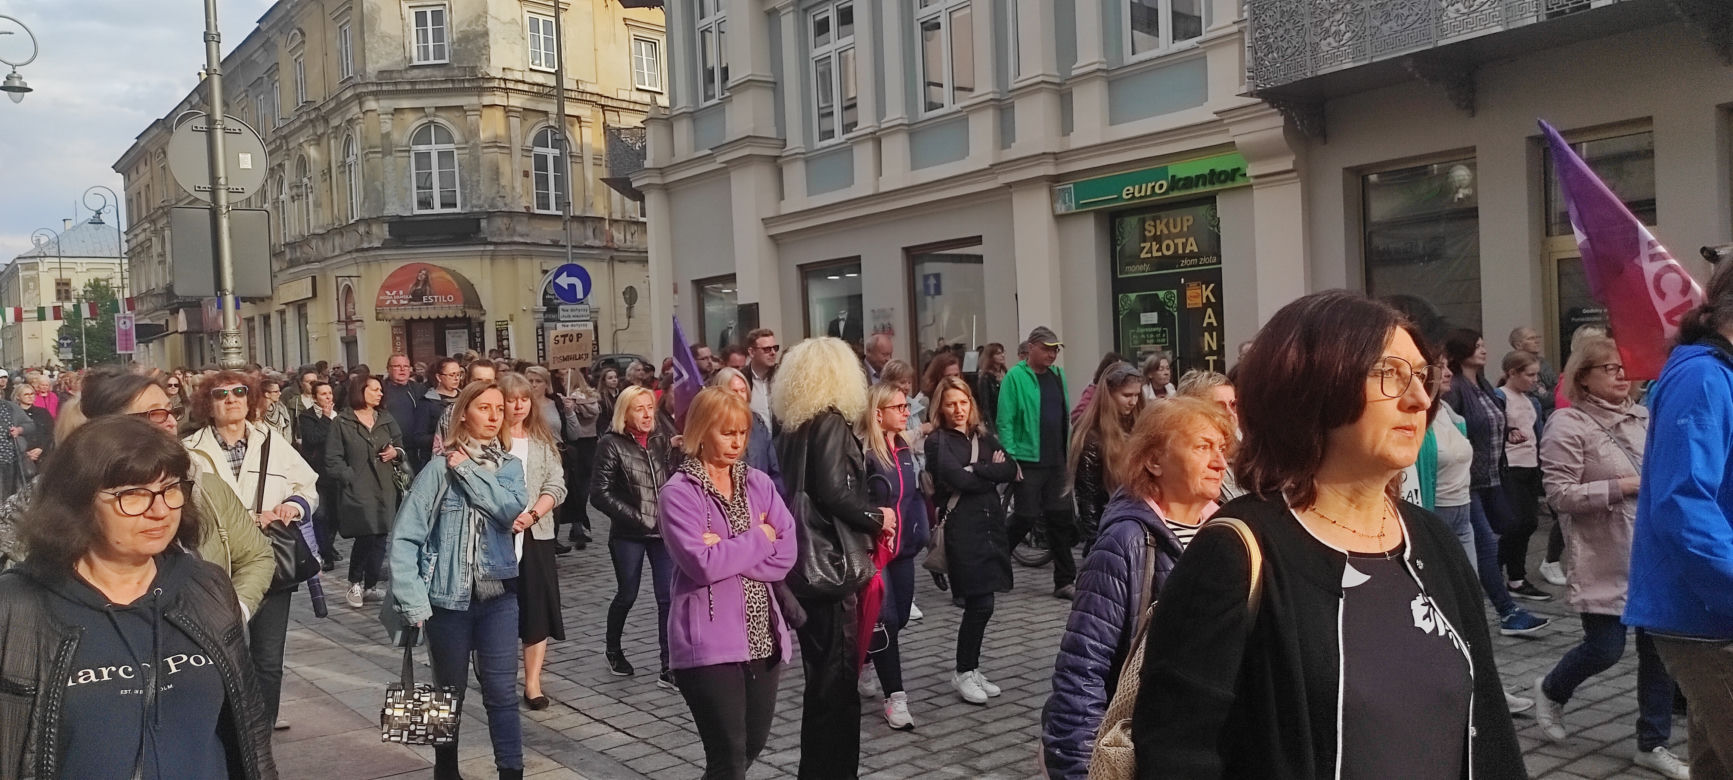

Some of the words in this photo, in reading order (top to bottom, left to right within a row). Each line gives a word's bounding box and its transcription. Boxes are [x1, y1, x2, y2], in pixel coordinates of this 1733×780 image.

[1144, 215, 1194, 237] SKUP
[1140, 237, 1198, 259] ZŁOTA
[422, 294, 454, 303] ESTILO
[553, 333, 583, 345] STOP
